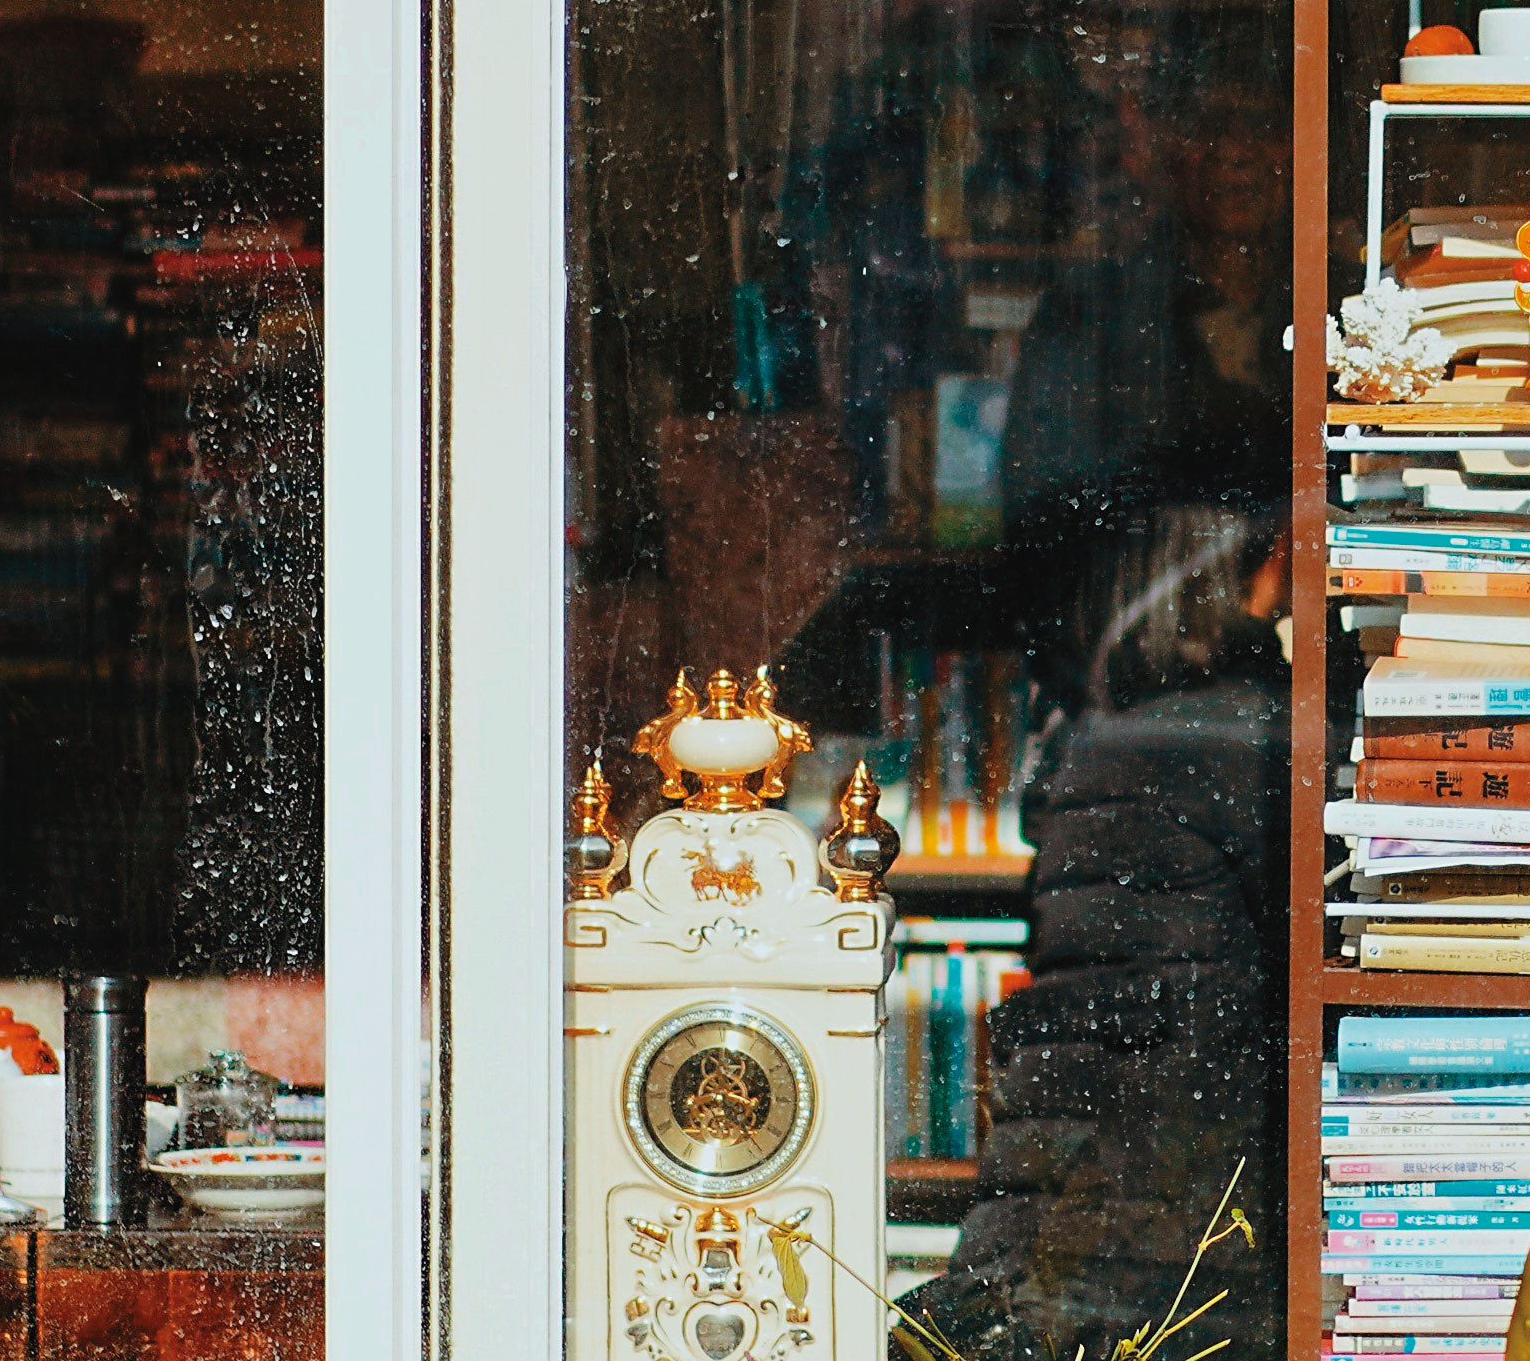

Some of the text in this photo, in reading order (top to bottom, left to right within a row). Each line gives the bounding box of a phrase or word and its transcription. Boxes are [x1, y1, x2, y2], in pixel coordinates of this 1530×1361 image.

[1402, 1161, 1518, 1176] 錯把太太當帽子的人
